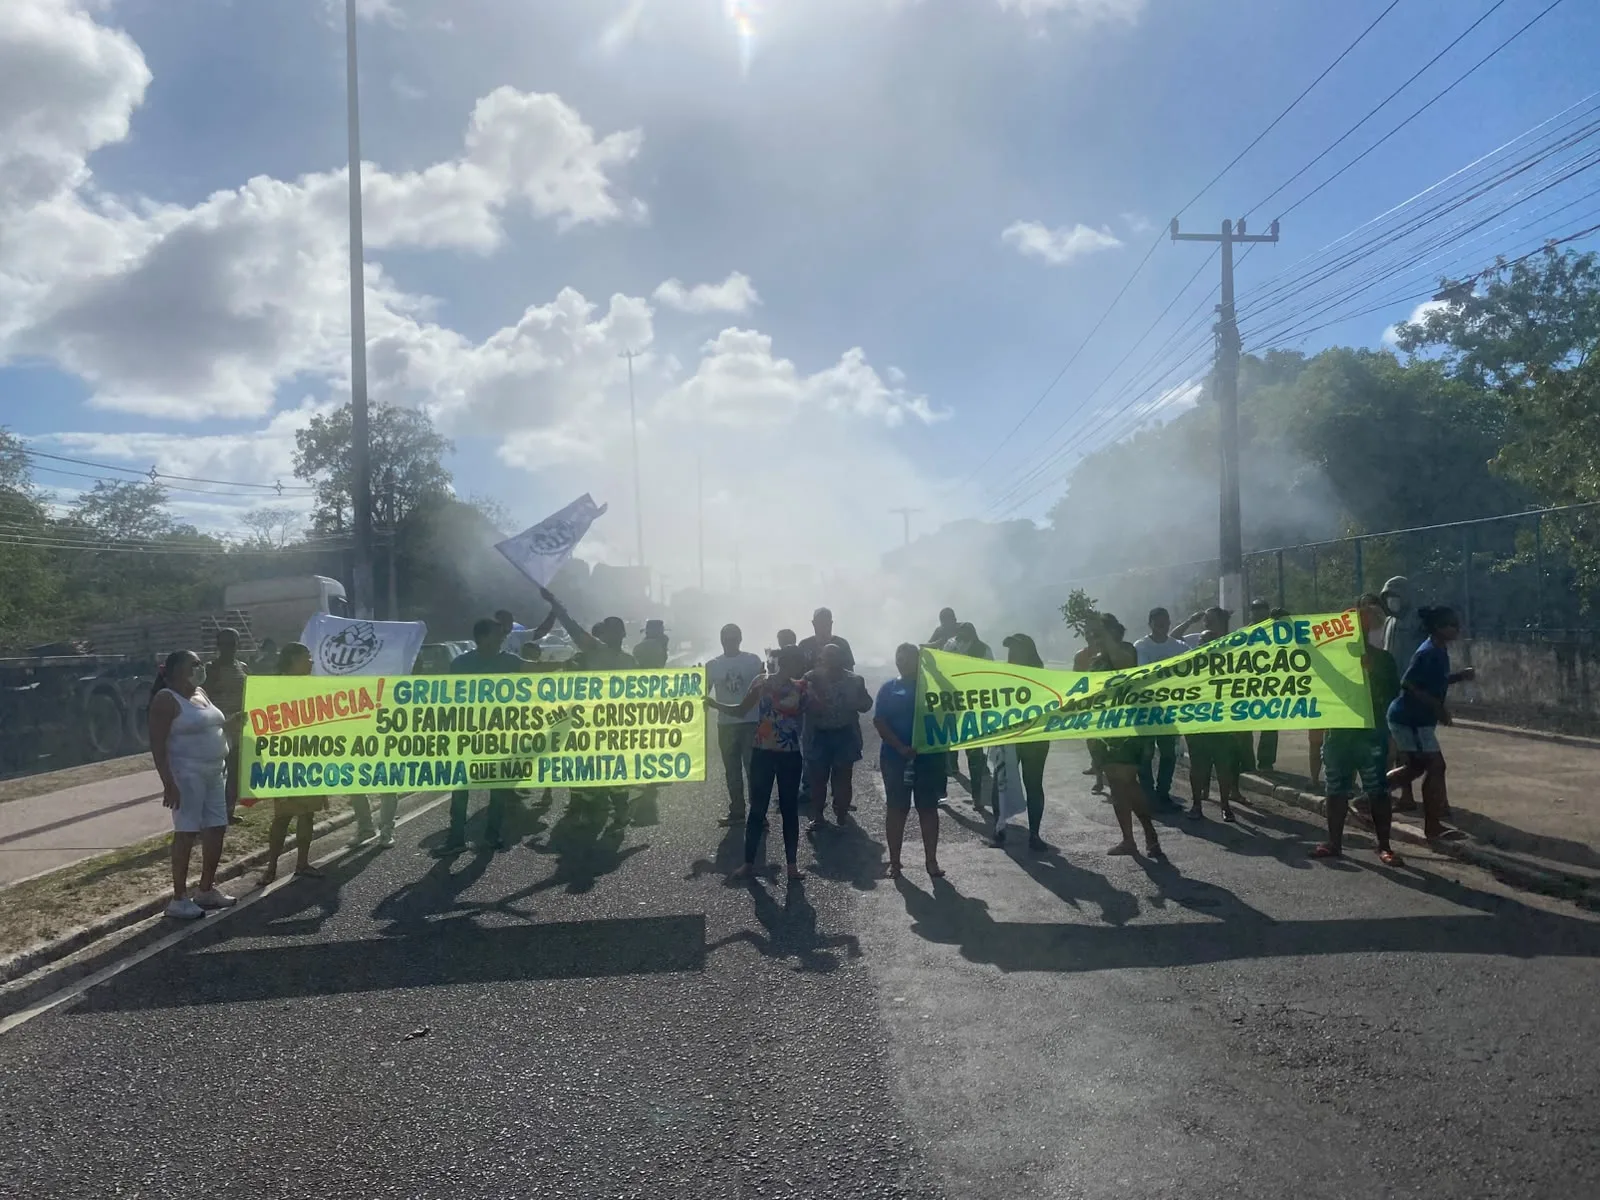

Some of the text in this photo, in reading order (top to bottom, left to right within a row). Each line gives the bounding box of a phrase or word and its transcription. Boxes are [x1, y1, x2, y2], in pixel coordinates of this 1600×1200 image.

[1311, 613, 1355, 641] PEDE
[393, 673, 703, 705] GRILEIROS QUER DESPEJAR
[924, 686, 1032, 712] PREFEITO
[1066, 676, 1089, 697] A
[1208, 675, 1312, 700] TERRAS
[250, 678, 386, 736] DENUNCIA!
[376, 698, 694, 734] 50 FAMILIARES EM S. CRISTOVÃO
[1044, 697, 1322, 732] POR INTERESSE SOCIAL
[255, 728, 682, 757] PEDIMOS AO PODER PÚBLICO E AO PREFEITO
[250, 752, 692, 790] MARCOS SANTANA QUE NÃO PERMITA ISSO
